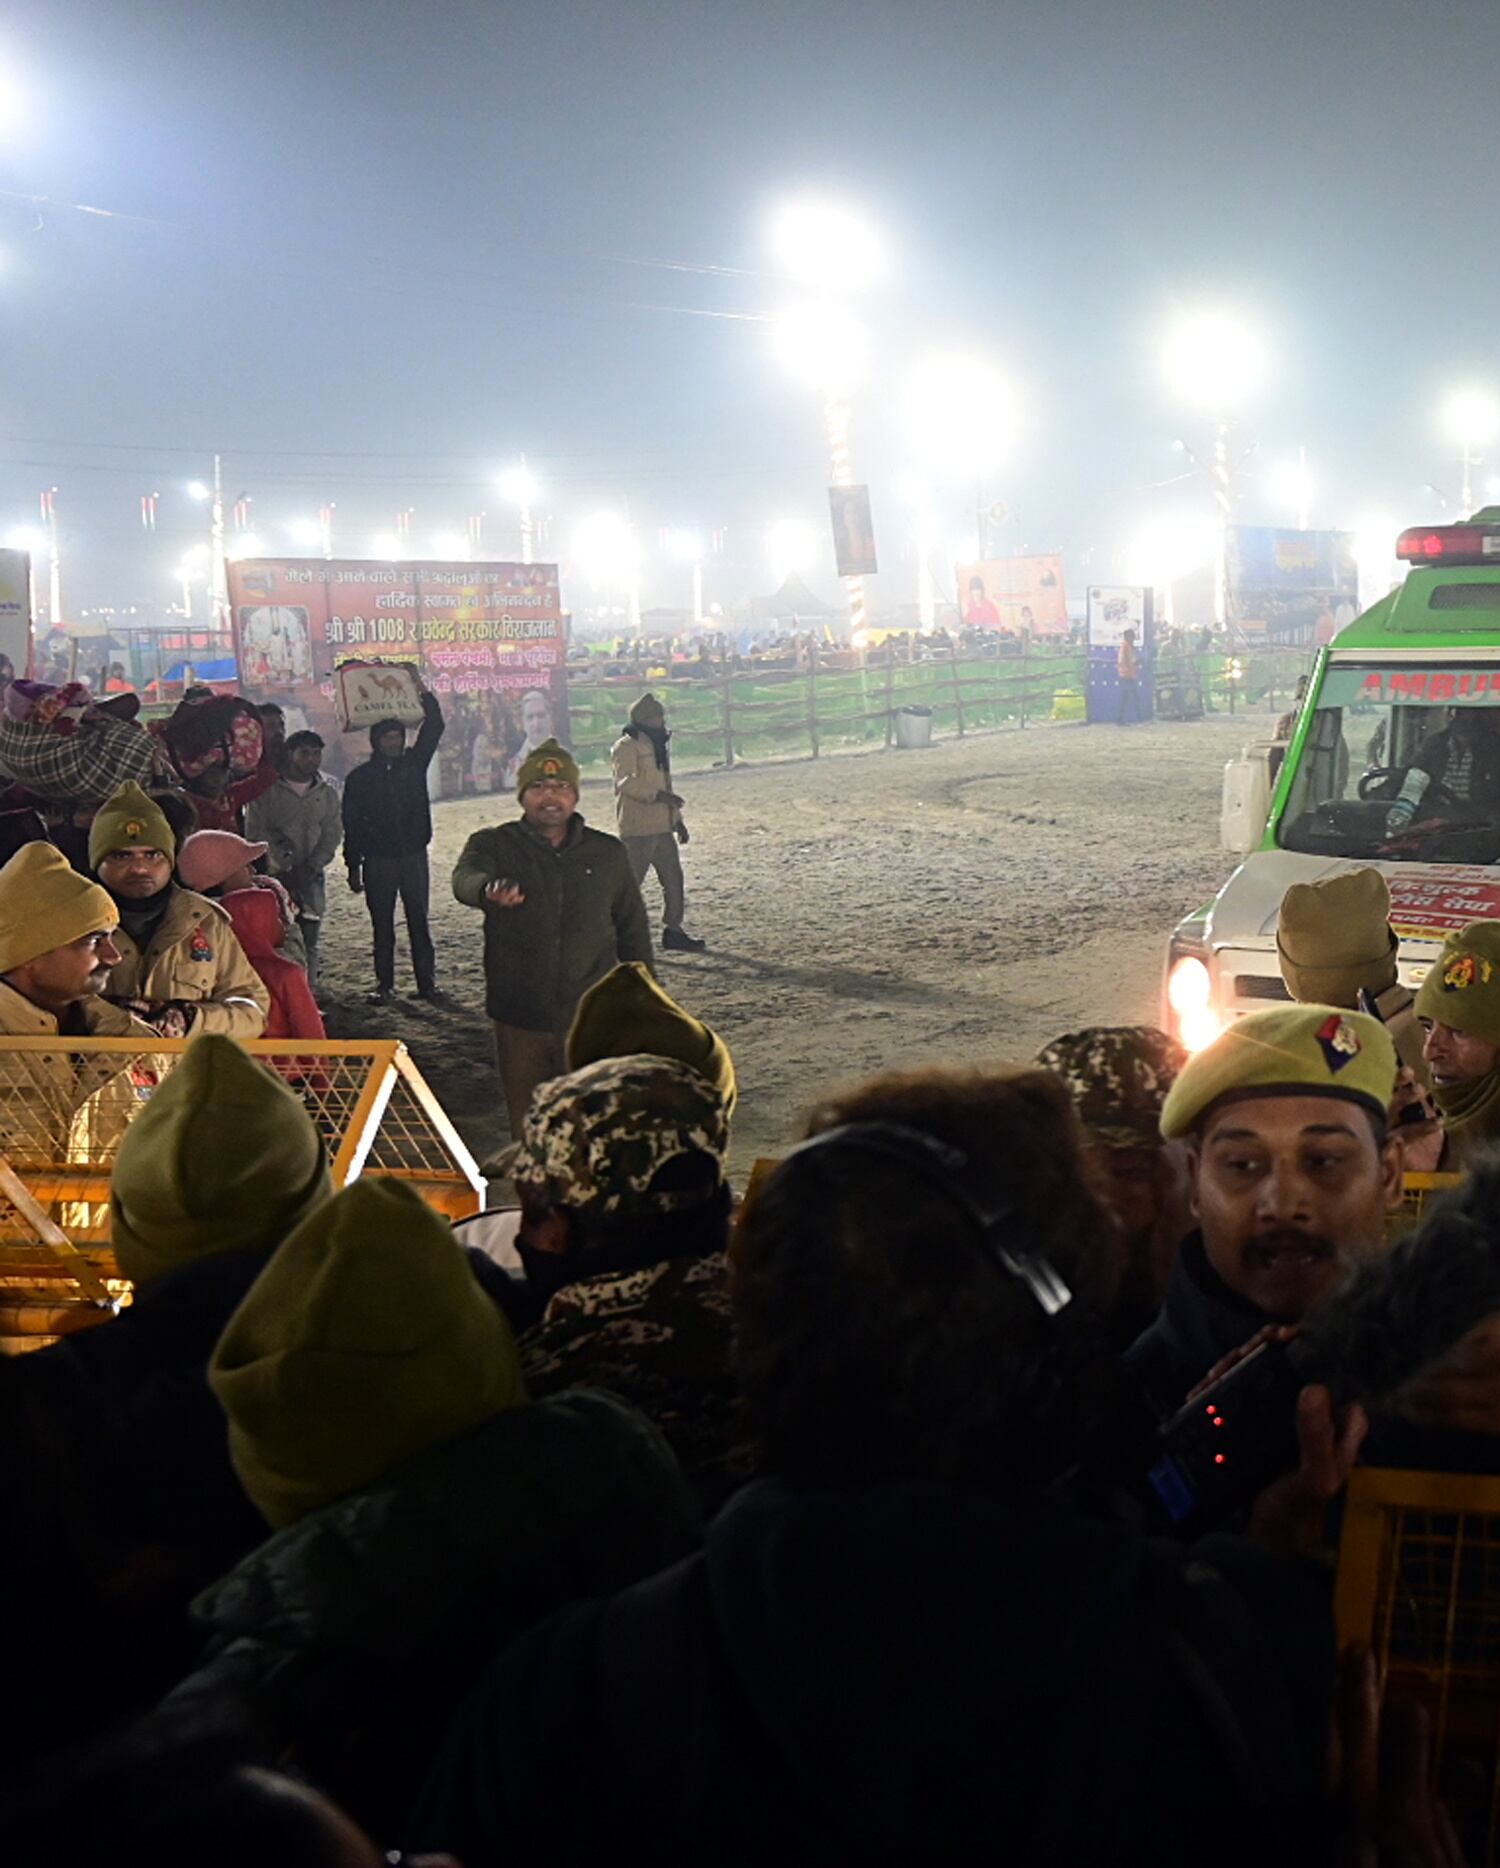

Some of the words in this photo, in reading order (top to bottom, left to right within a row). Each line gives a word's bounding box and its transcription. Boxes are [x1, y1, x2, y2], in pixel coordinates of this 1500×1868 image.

[325, 616, 344, 644] श्री
[347, 616, 366, 644] श्री
[369, 616, 405, 642] 1008
[354, 701, 393, 712] CAMEL
[397, 700, 417, 710] TEA
